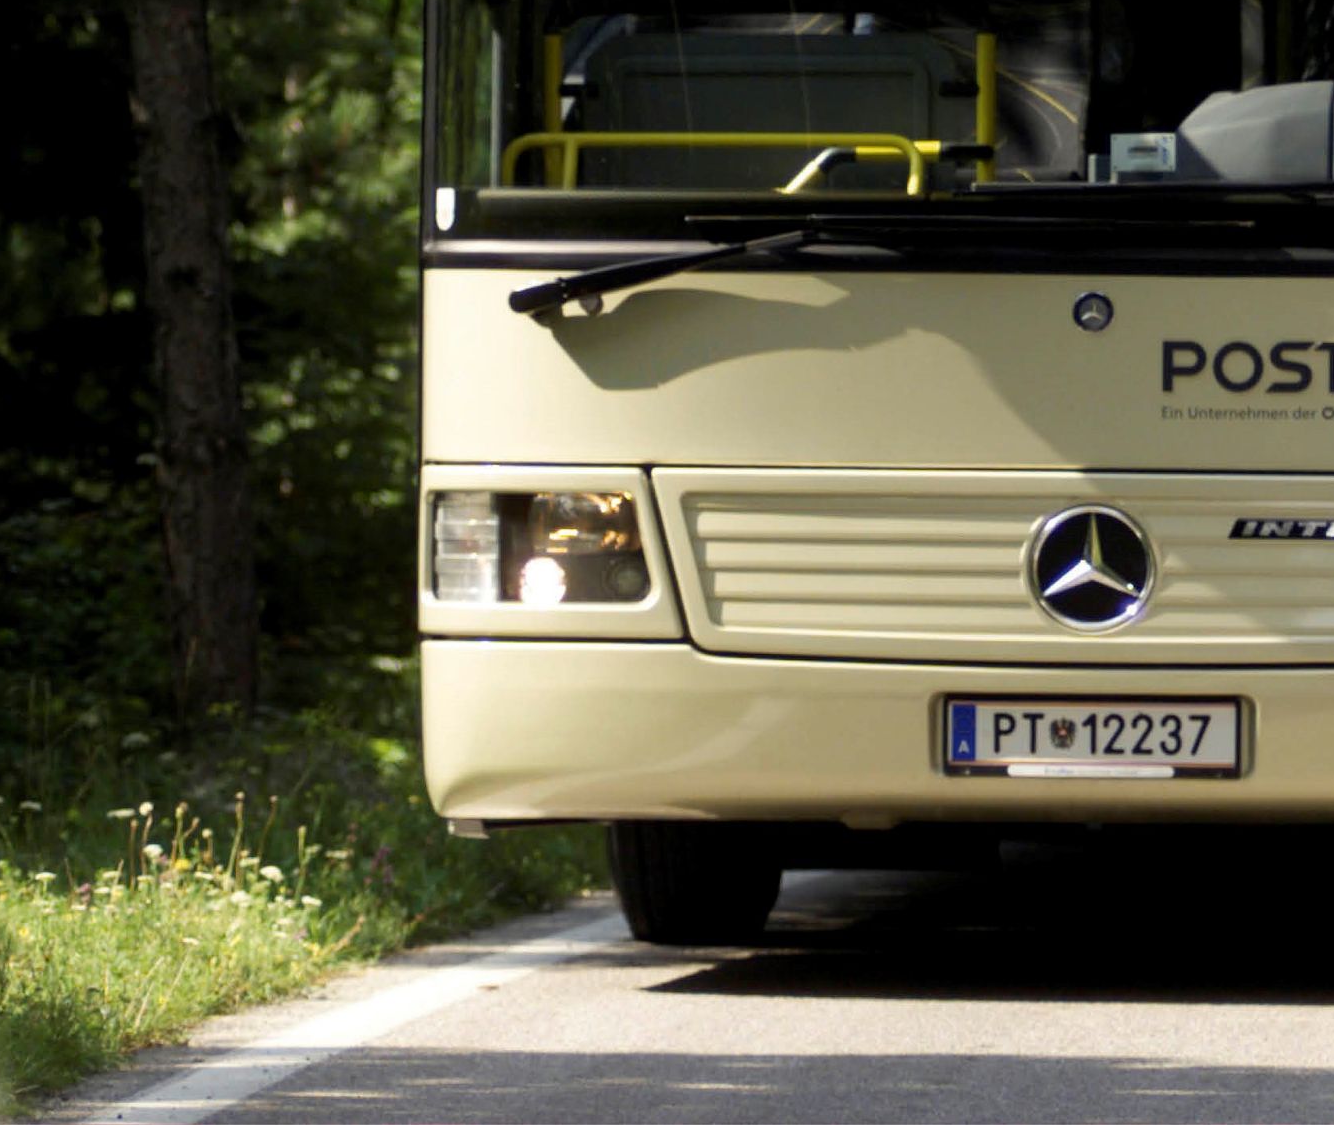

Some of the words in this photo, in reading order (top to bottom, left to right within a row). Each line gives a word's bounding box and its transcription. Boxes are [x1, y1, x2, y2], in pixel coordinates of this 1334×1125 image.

[1161, 406, 1182, 420] Ein
[1188, 405, 1288, 421] Unternehmen
[1292, 405, 1317, 420] der
[992, 712, 1045, 755] PT
[1081, 712, 1212, 756] 12237
[957, 740, 970, 755] A
